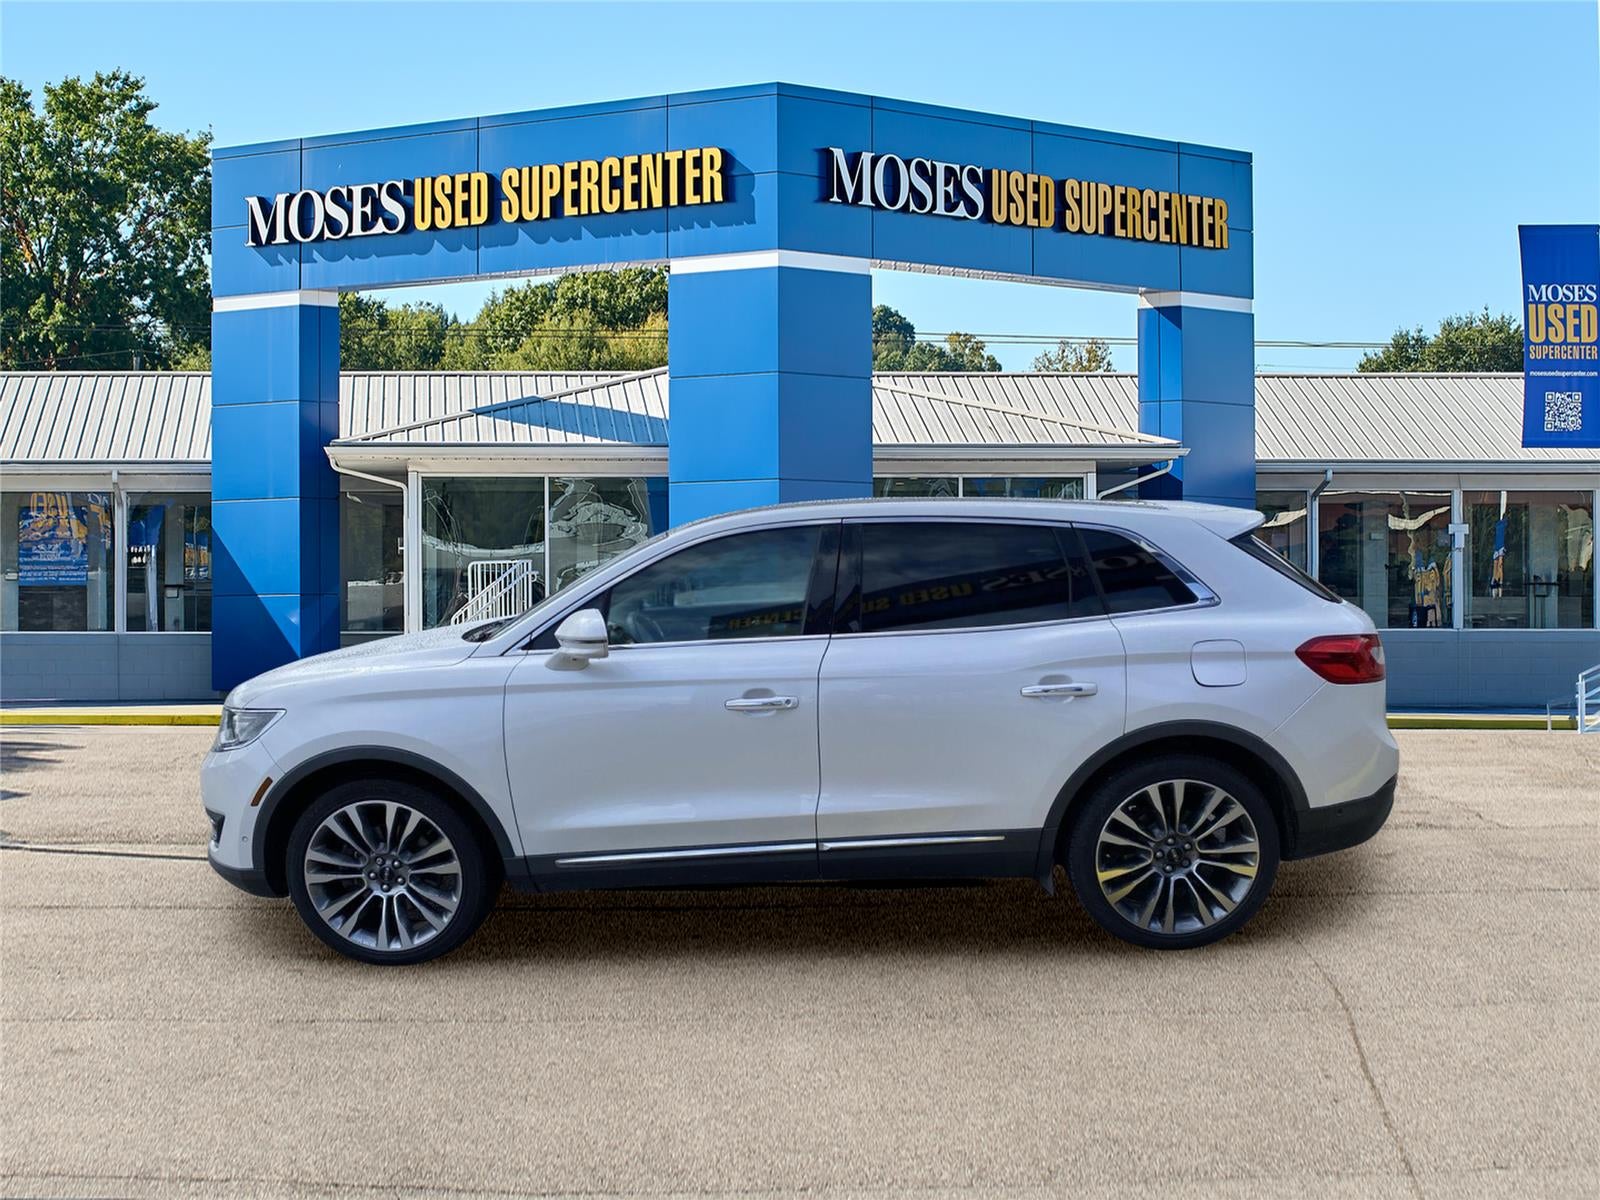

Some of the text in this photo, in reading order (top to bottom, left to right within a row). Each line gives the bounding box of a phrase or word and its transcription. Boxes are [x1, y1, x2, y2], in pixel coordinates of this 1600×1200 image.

[245, 147, 724, 247] MOSES USED SUPERCENTER
[828, 147, 1229, 249] MOSES USED SUPERCENTER
[1528, 284, 1597, 303] MOSES
[1528, 304, 1598, 343] USED
[1529, 345, 1598, 360] SUPERCENTER
